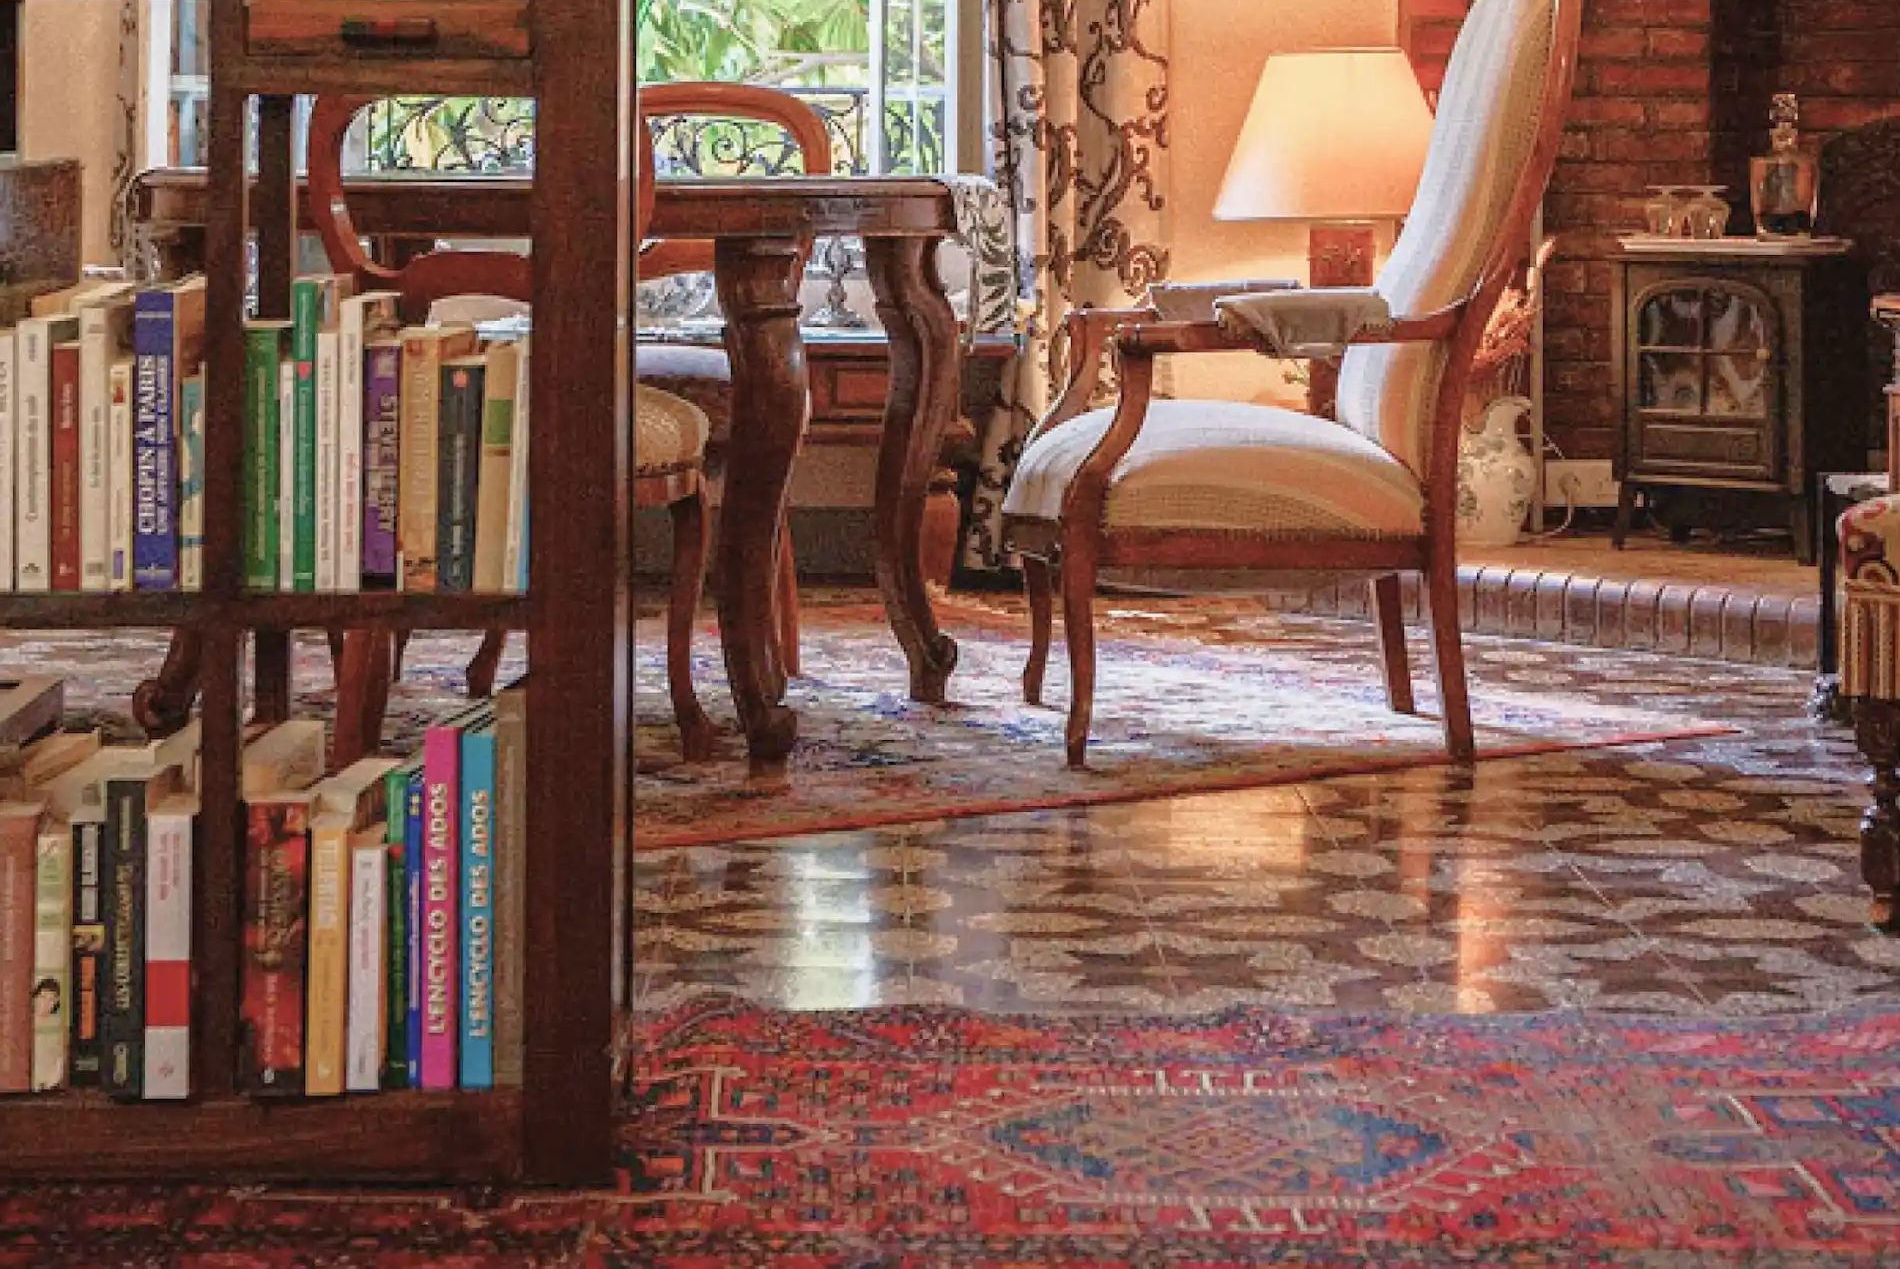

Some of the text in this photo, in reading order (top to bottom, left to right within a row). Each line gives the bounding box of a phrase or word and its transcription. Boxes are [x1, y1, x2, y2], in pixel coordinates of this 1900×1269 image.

[137, 354, 156, 422] PARIS
[379, 393, 398, 464] STEVE
[137, 445, 156, 534] CHOPIN
[428, 782, 449, 1035] L'ENCYCLO DES ADOS
[468, 788, 490, 1037] L'ENCYCLO DES ADOS
